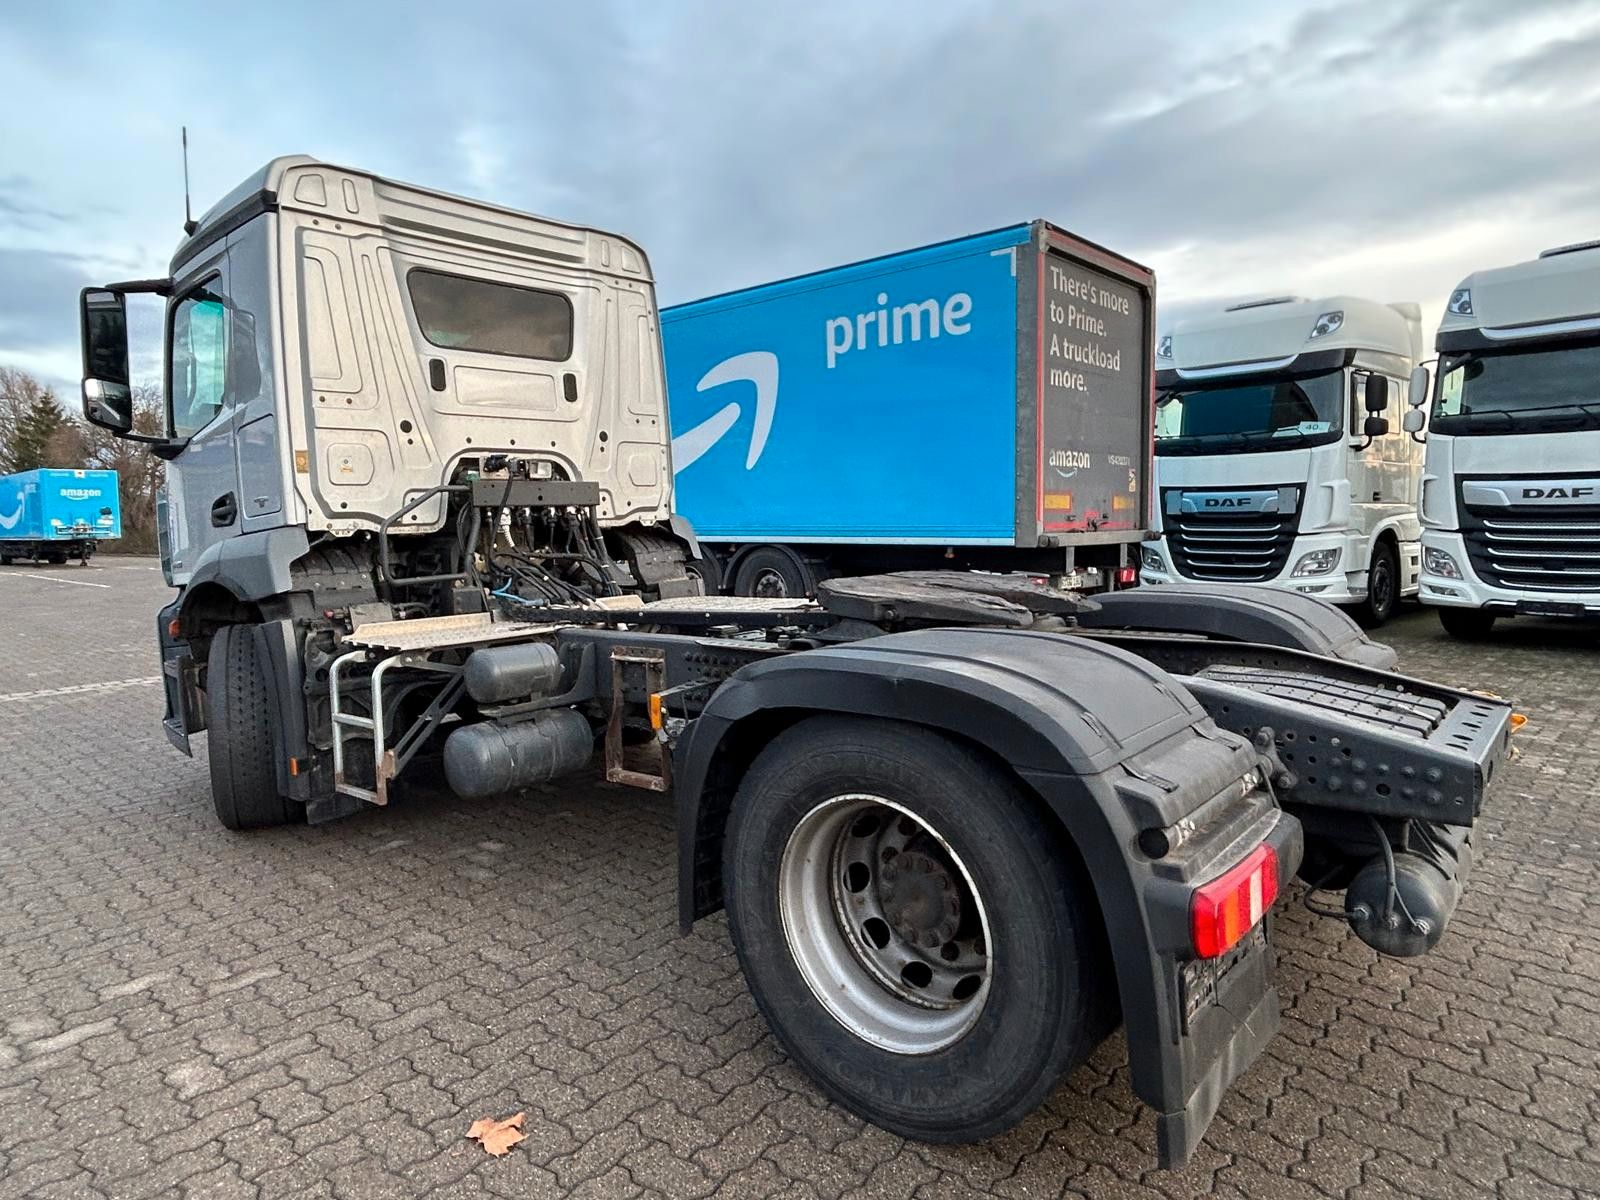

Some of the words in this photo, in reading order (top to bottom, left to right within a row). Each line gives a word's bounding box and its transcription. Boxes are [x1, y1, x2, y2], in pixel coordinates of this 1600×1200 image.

[1050, 266, 1097, 304] There's
[1100, 289, 1129, 315] more
[826, 292, 973, 369] prime
[1050, 300, 1064, 324] to
[1068, 305, 1107, 337] Prime.
[1050, 334, 1060, 357] A
[1063, 338, 1121, 371] truckload
[1050, 368, 1088, 392] more.
[1049, 448, 1091, 469] amazon
[60, 488, 102, 497] amazon
[1205, 498, 1252, 507] DAF
[1522, 487, 1594, 498] DAF
